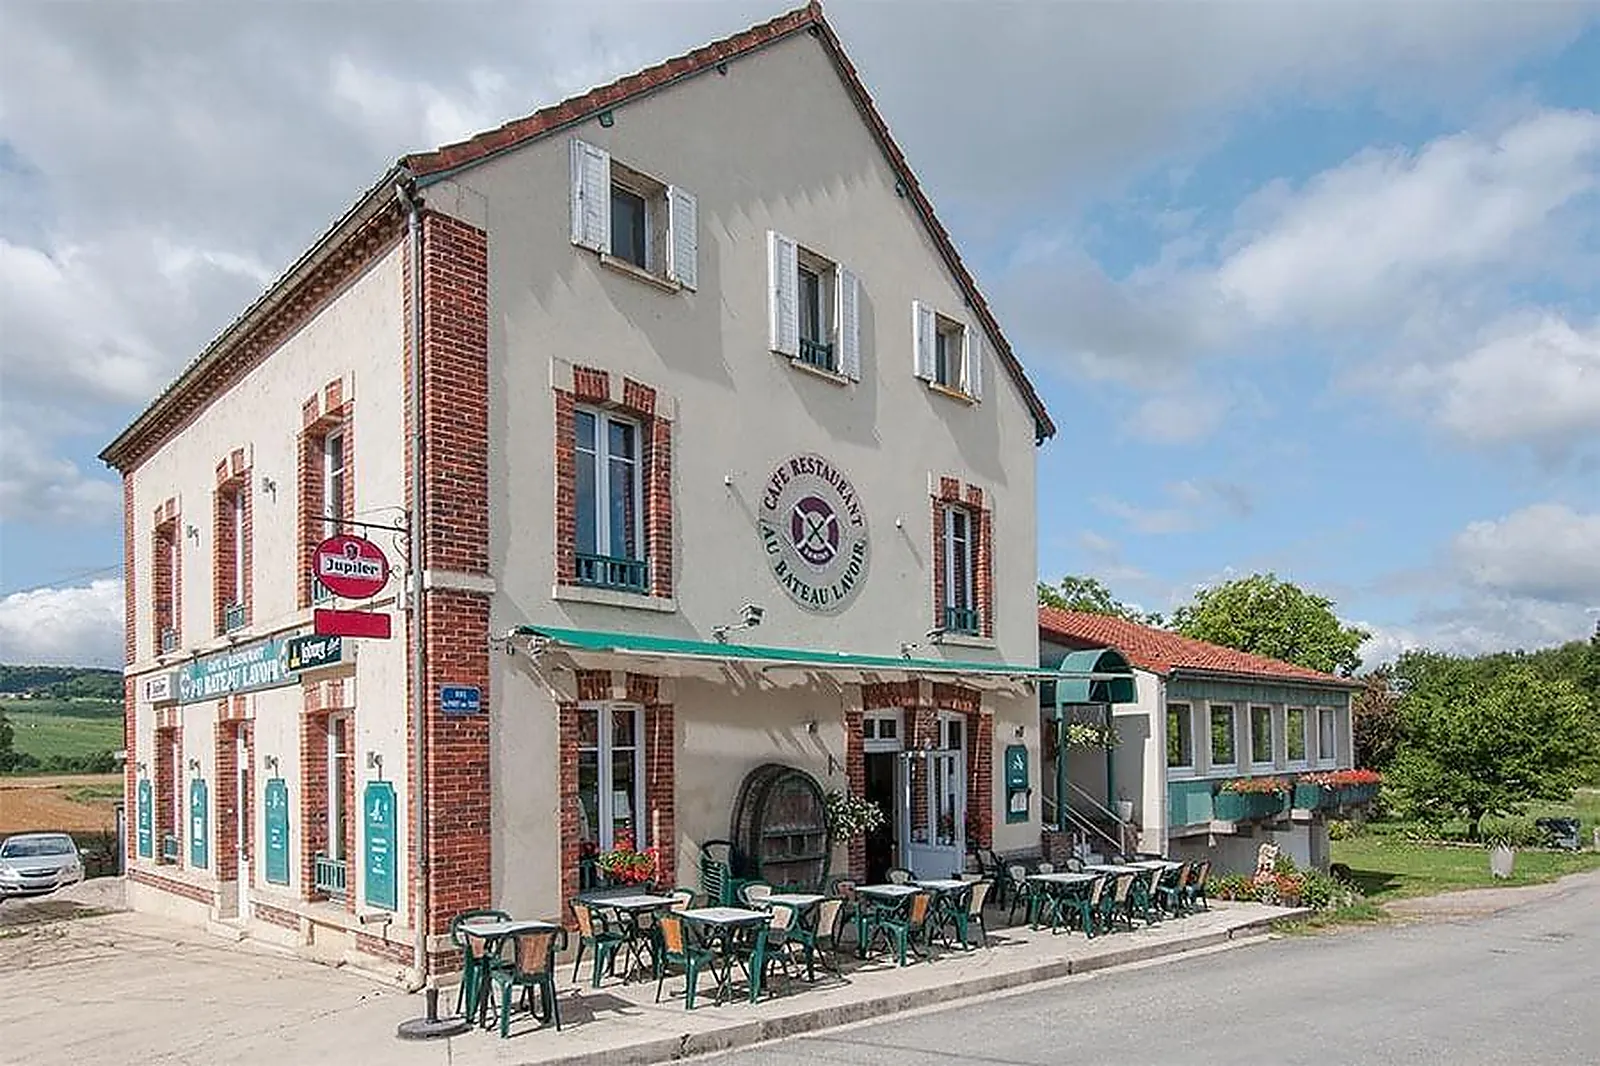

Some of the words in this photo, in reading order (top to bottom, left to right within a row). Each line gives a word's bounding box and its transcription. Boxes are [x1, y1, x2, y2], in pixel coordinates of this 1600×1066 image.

[764, 467, 790, 511] CAFE
[790, 457, 863, 528] RESTAURANT
[326, 557, 379, 575] Jupiler
[762, 525, 781, 555] AU
[774, 560, 828, 605] BATEAU
[832, 542, 865, 600] LAVOIR
[204, 666, 240, 695] BATEAU
[242, 659, 279, 687] LAVOIR
